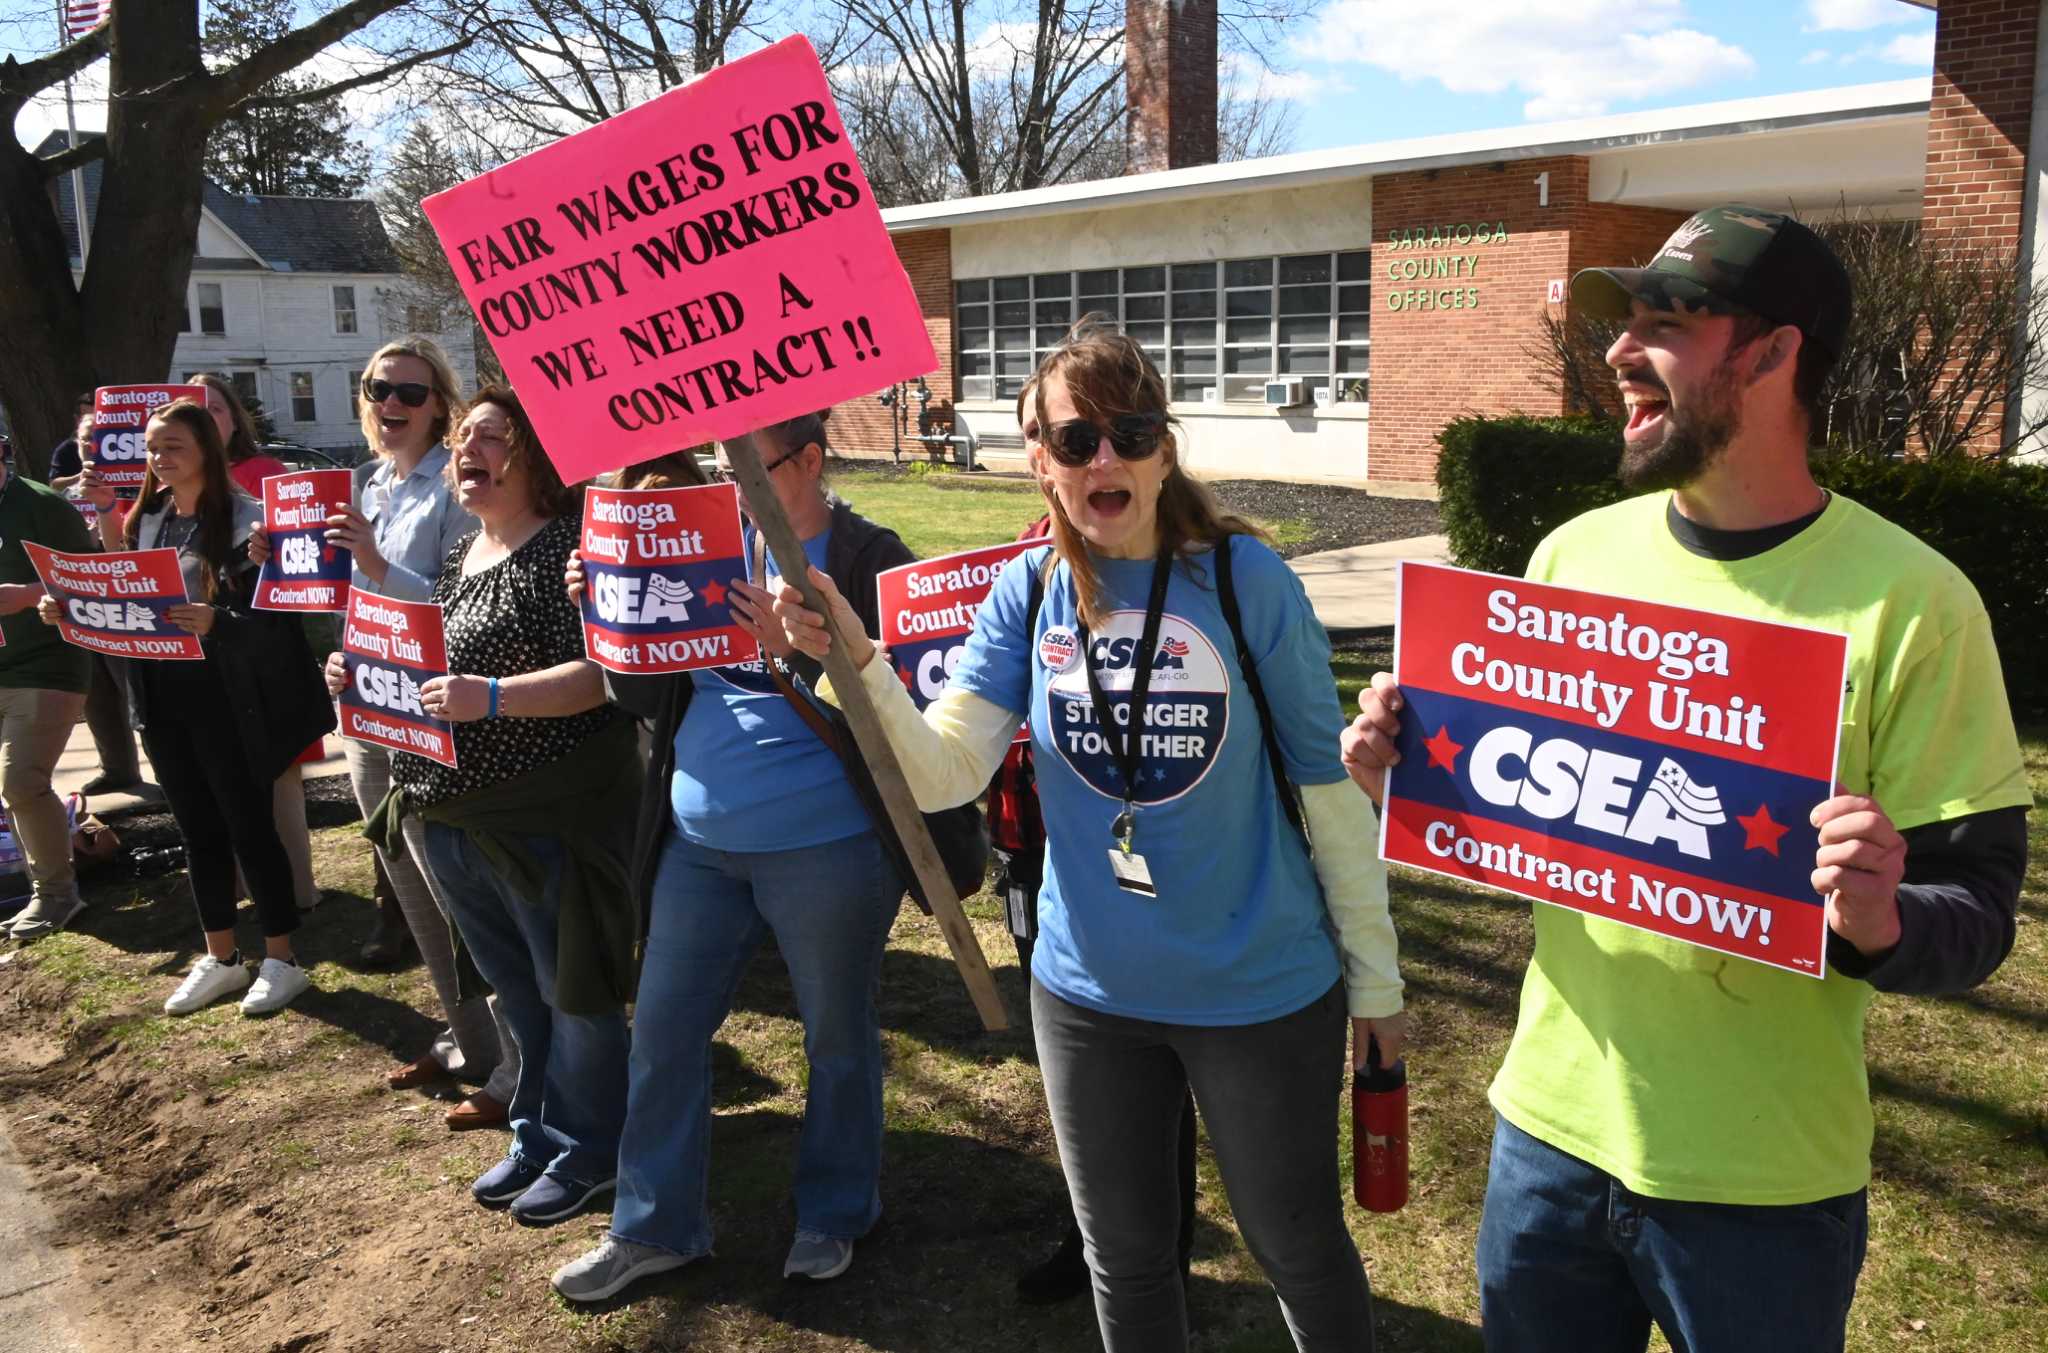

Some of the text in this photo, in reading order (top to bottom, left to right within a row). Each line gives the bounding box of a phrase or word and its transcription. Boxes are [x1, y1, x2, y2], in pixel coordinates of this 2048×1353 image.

[458, 99, 839, 284] FAIR WAGES FOR
[1533, 171, 1549, 207] 1
[480, 161, 861, 338] COUNTY WORKERS
[1388, 221, 1508, 250] SARATOGA
[1387, 255, 1479, 281] COUNTY
[1387, 287, 1479, 311] OFFICES
[1551, 283, 1560, 300] A
[531, 271, 814, 391] WE NEED A
[607, 326, 838, 432] CONTRACT
[101, 391, 170, 407] Saratoga
[96, 409, 141, 426] County
[101, 432, 147, 461] CSE
[277, 481, 314, 502] Saratoga
[275, 502, 327, 529] County Unit
[592, 495, 676, 531] Saratoga
[281, 534, 320, 574] CSEA
[585, 527, 705, 564] County Unit
[49, 553, 138, 578] Saratoga
[906, 558, 1009, 600] Saratog
[49, 569, 160, 597] County Unit
[269, 586, 335, 604] Contract NOW!
[594, 572, 695, 625] CSEA
[68, 599, 157, 631] CSEA
[354, 596, 409, 634] Saratoga
[70, 628, 185, 654] Contract NOW!
[347, 624, 424, 663] County Unit
[592, 632, 641, 665] Contract
[646, 634, 730, 665] NOW!
[1041, 643, 1075, 657] CONTRACT
[1044, 632, 1077, 648] CSEA
[1486, 588, 1731, 682] Saratoga
[1047, 655, 1065, 666] NOW!
[355, 663, 425, 717] CSEA
[1450, 642, 1767, 752] County Unit
[352, 713, 444, 755] Contract NOW!
[1468, 725, 1727, 860] CSEA
[1424, 820, 1773, 946] Contract NOW!
